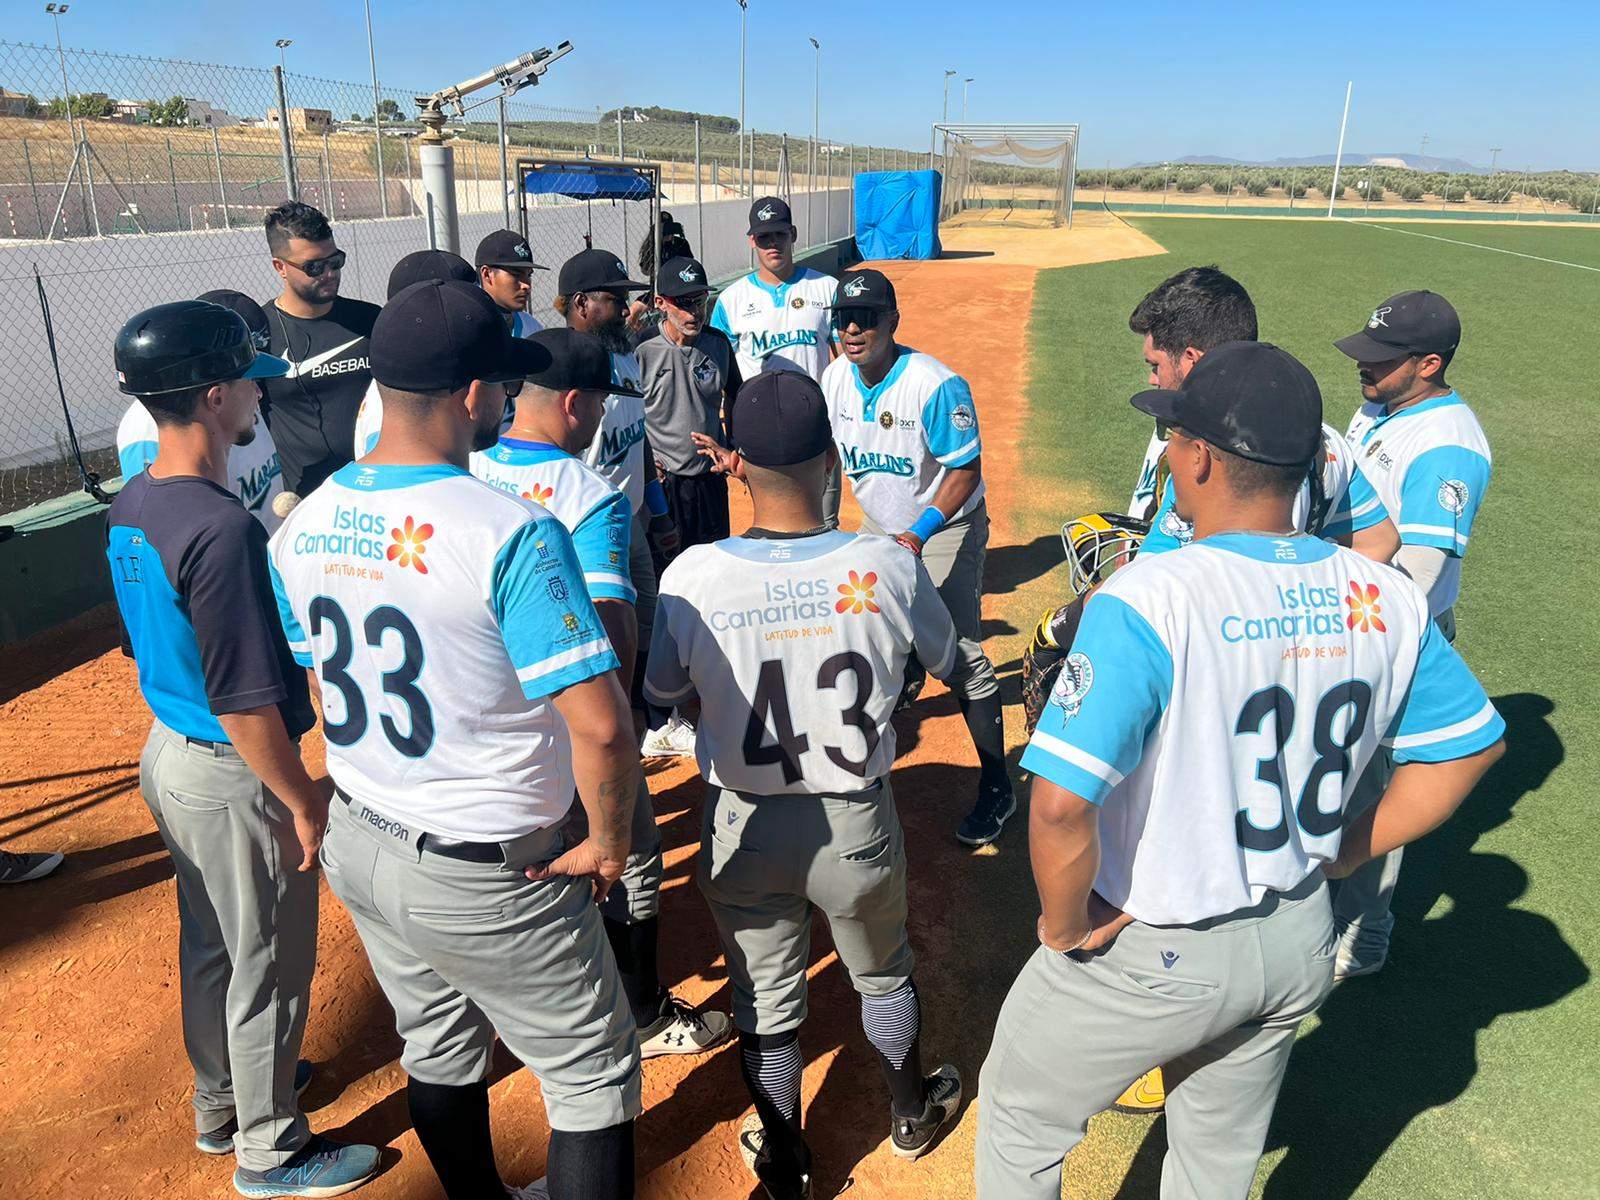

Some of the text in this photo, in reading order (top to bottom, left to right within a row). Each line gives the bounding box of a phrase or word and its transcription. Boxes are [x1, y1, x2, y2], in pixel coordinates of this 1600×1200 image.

[750, 329, 819, 361] MARLINS
[312, 357, 371, 378] BASEBAL
[599, 416, 646, 468] MARLI
[841, 442, 916, 483] MARLINS
[333, 504, 386, 536] Islas
[294, 531, 384, 561] Canarias
[324, 562, 384, 581] LATITUD DE VIDA
[764, 578, 829, 602] Islas
[1276, 582, 1341, 609] Islas
[710, 600, 832, 632] Canarias
[1221, 609, 1344, 643] Canarias
[764, 625, 833, 641] LATITUD DE VIDA
[1281, 646, 1348, 660] LATUD DE VIDA
[306, 593, 437, 760] 33
[742, 651, 881, 787] 43
[1234, 677, 1373, 854] 38
[359, 806, 409, 842] macron
